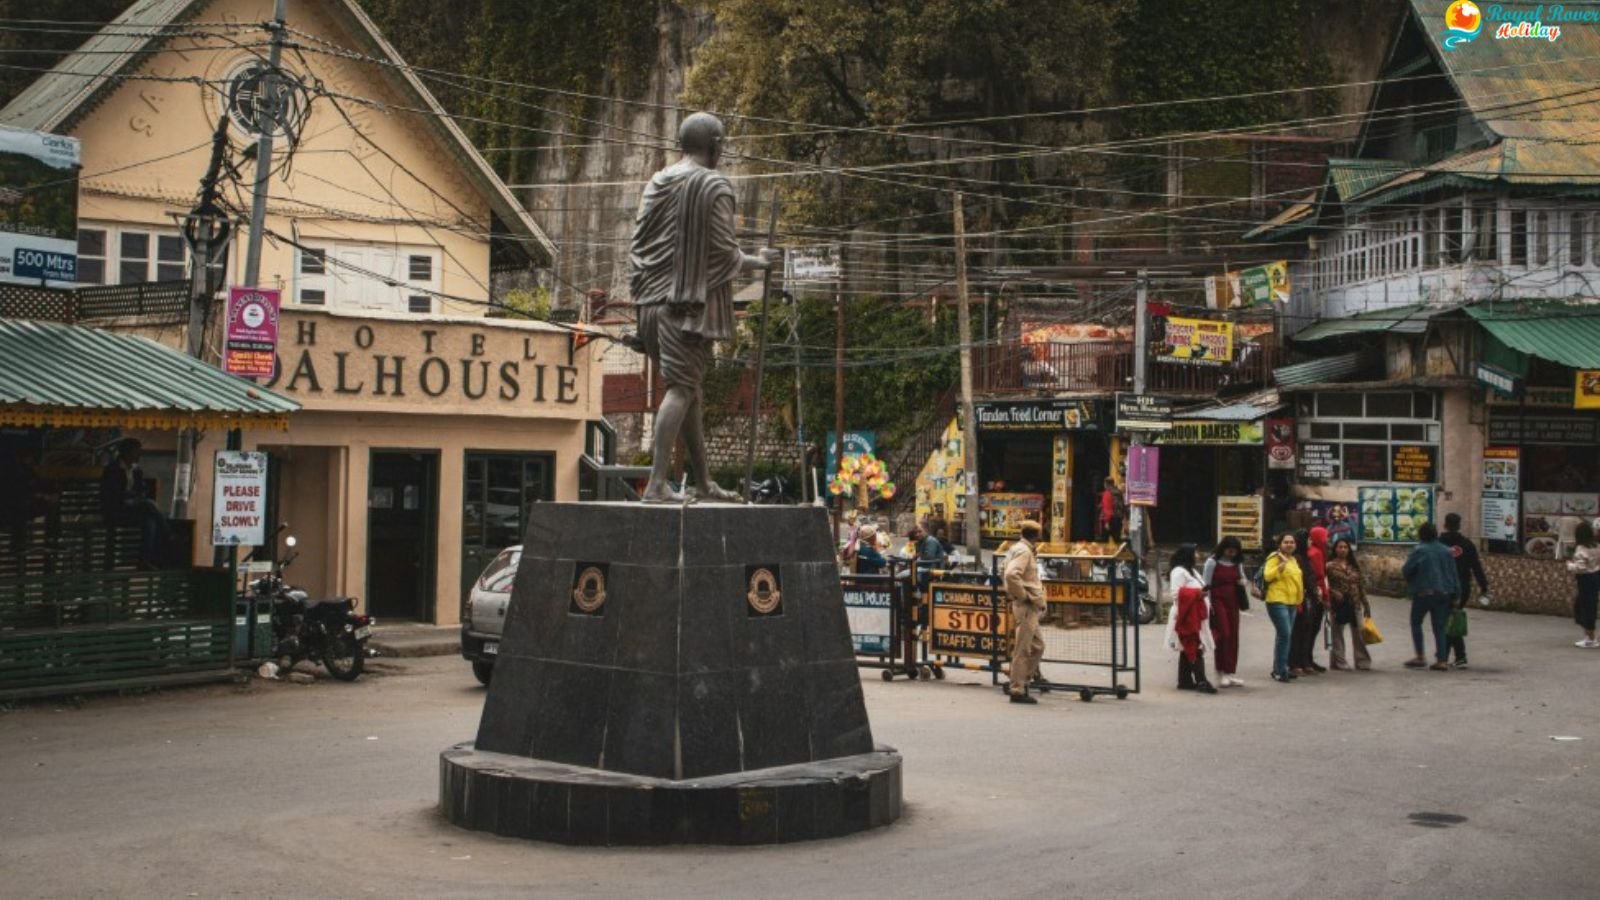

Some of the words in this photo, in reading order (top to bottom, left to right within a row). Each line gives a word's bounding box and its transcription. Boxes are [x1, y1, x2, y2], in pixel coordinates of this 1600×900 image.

[17, 250, 43, 267] 500
[47, 254, 74, 271] Mtrs
[297, 320, 537, 360] HOTEL
[1010, 406, 1031, 422] Food
[1032, 406, 1062, 421] Corner
[1200, 424, 1239, 440] BAKERS
[223, 486, 260, 497] PLEASE
[226, 501, 256, 511] DRIVE
[221, 516, 260, 527] SLOWLY
[865, 592, 891, 606] POLICE
[1069, 585, 1107, 599] POLICE
[937, 632, 976, 648] TRAFFIC
